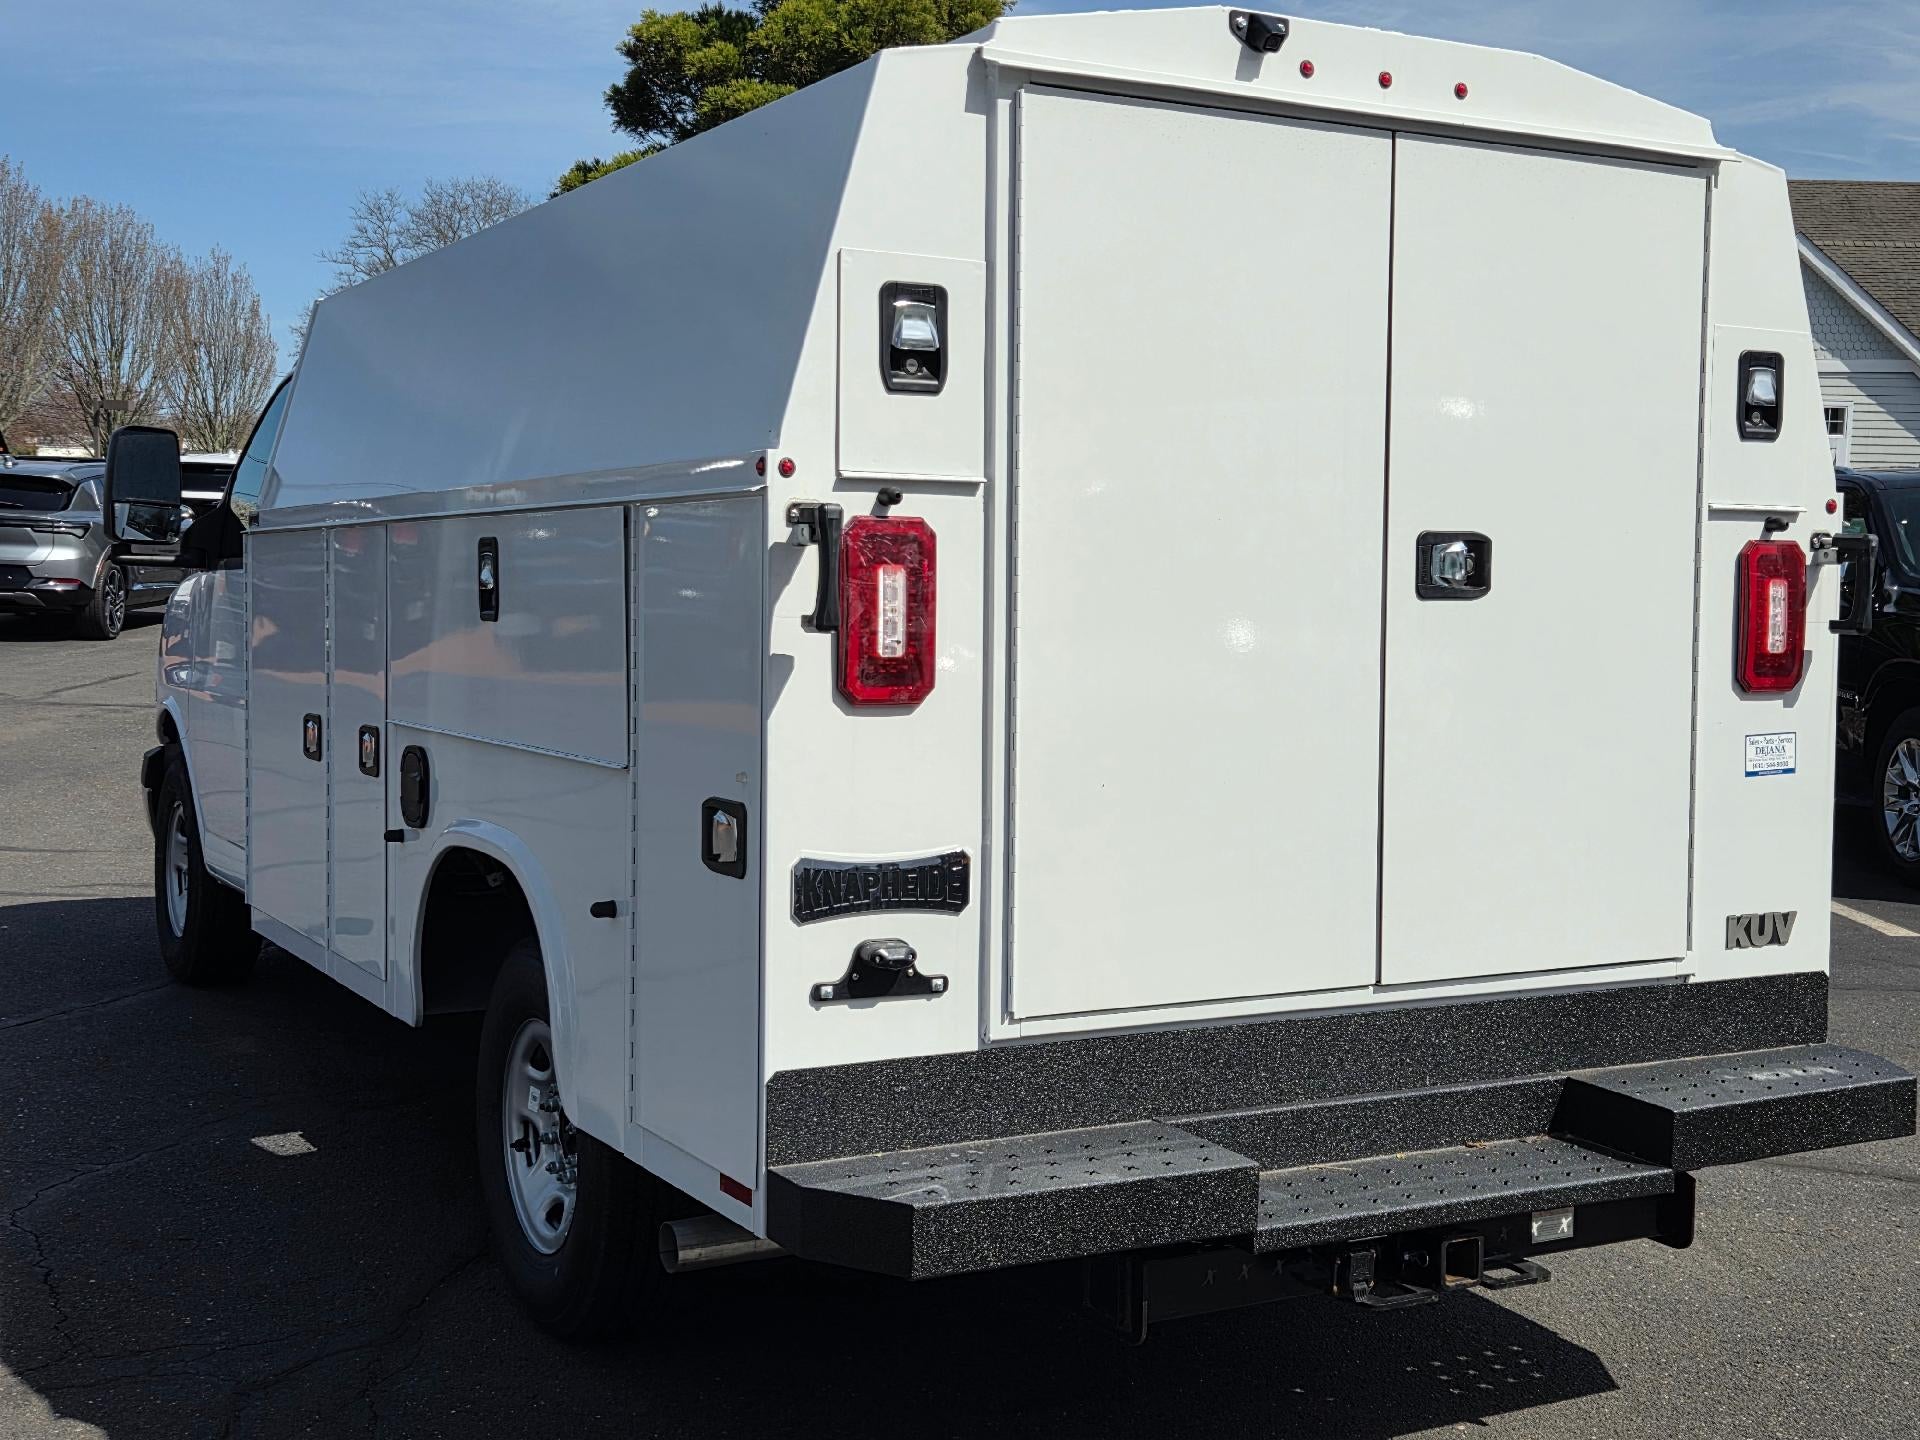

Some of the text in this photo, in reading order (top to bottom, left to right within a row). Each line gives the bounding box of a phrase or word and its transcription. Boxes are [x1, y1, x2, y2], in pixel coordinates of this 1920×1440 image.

[1755, 745, 1787, 756] DEJANA
[798, 856, 964, 914] KNAPHEIDE
[1725, 911, 1798, 950] KUV
